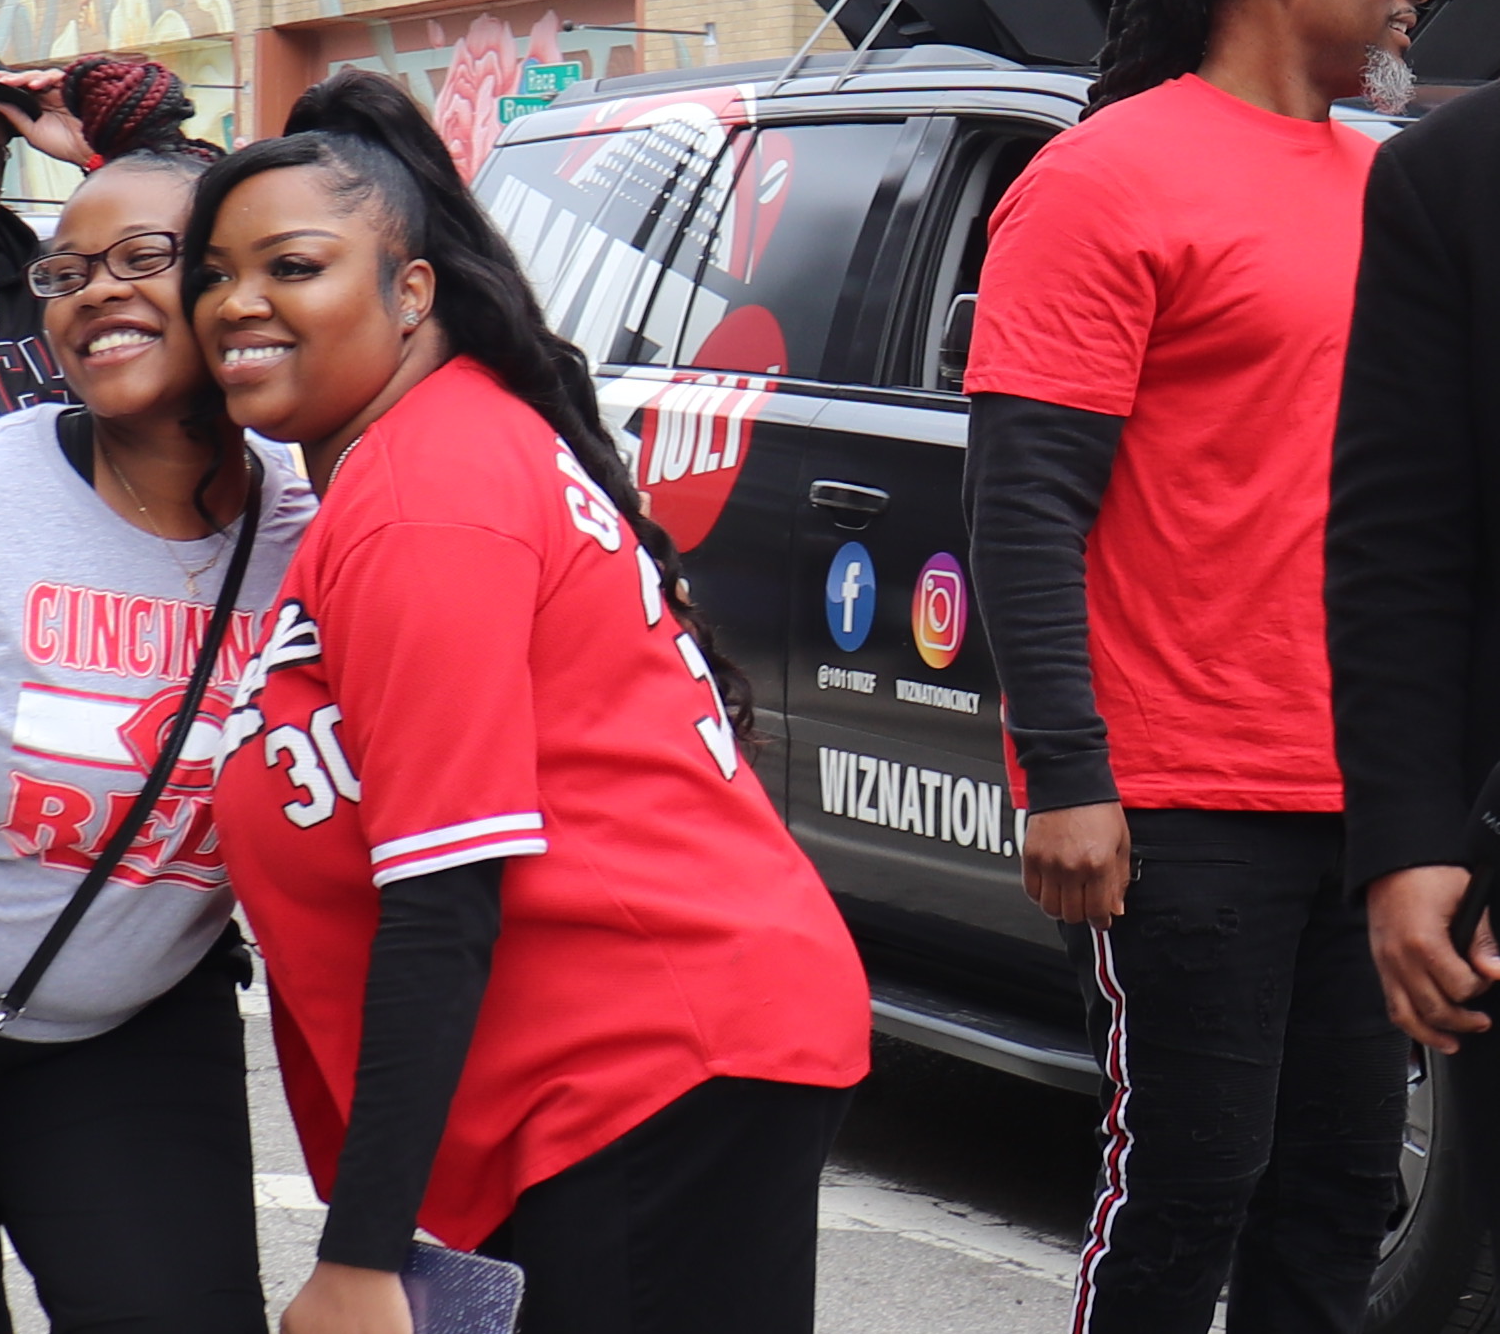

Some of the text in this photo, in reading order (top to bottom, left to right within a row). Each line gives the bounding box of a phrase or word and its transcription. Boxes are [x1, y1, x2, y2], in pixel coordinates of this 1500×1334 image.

[527, 69, 557, 91] Race
[22, 581, 275, 687] CINCINN
[896, 679, 980, 715] WIZNATIONCINCY
